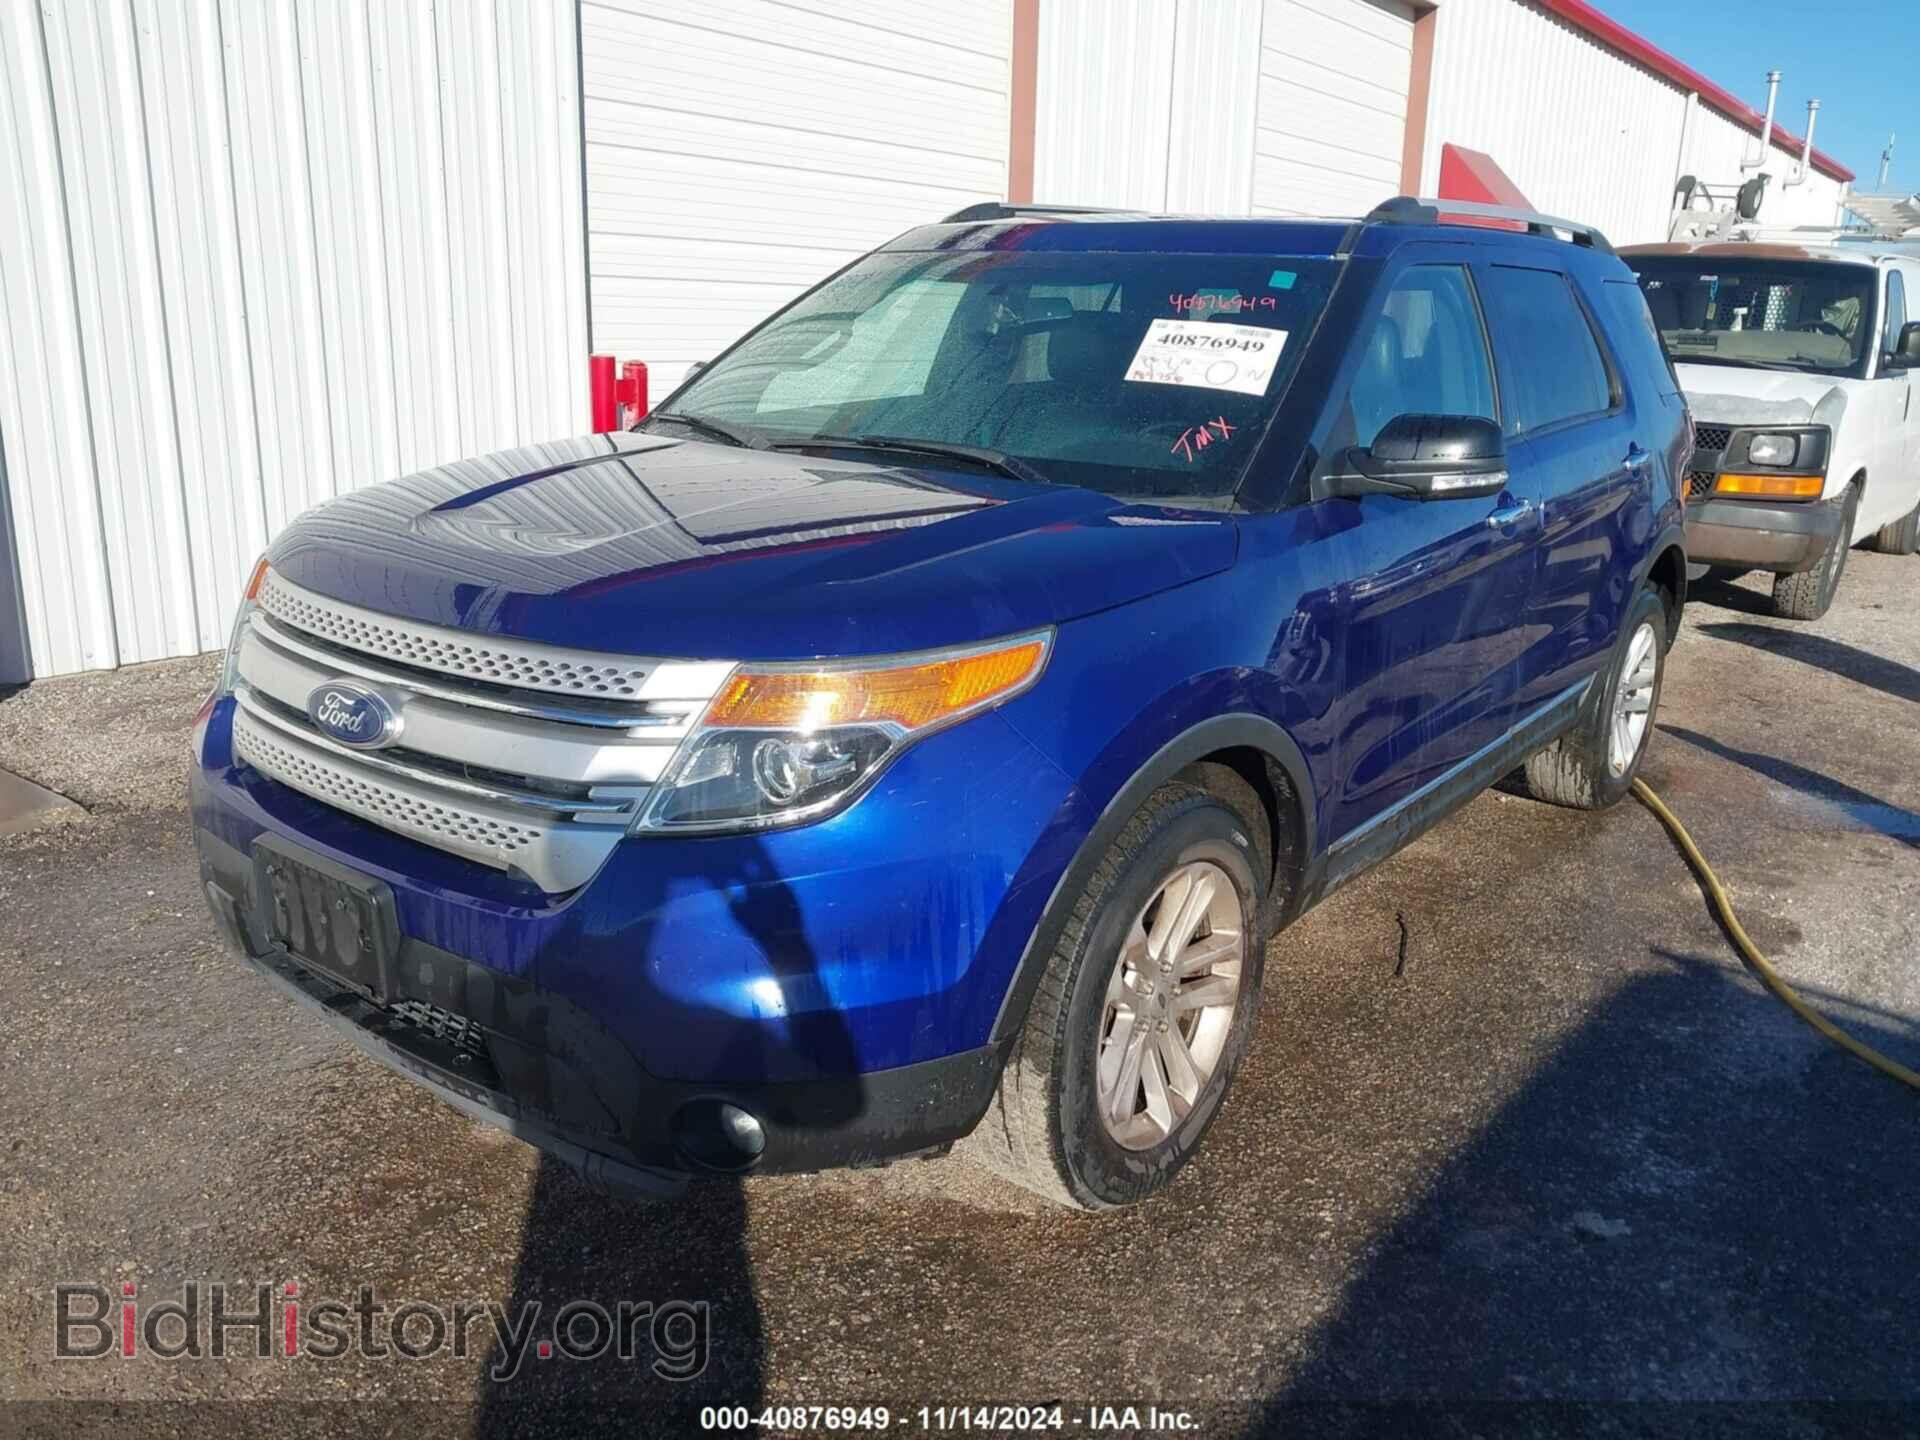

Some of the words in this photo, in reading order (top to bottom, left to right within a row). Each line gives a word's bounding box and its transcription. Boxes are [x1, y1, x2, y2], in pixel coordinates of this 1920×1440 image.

[1156, 332, 1265, 353] 40876949
[1170, 415, 1239, 464] TMX
[317, 691, 366, 733] Ford
